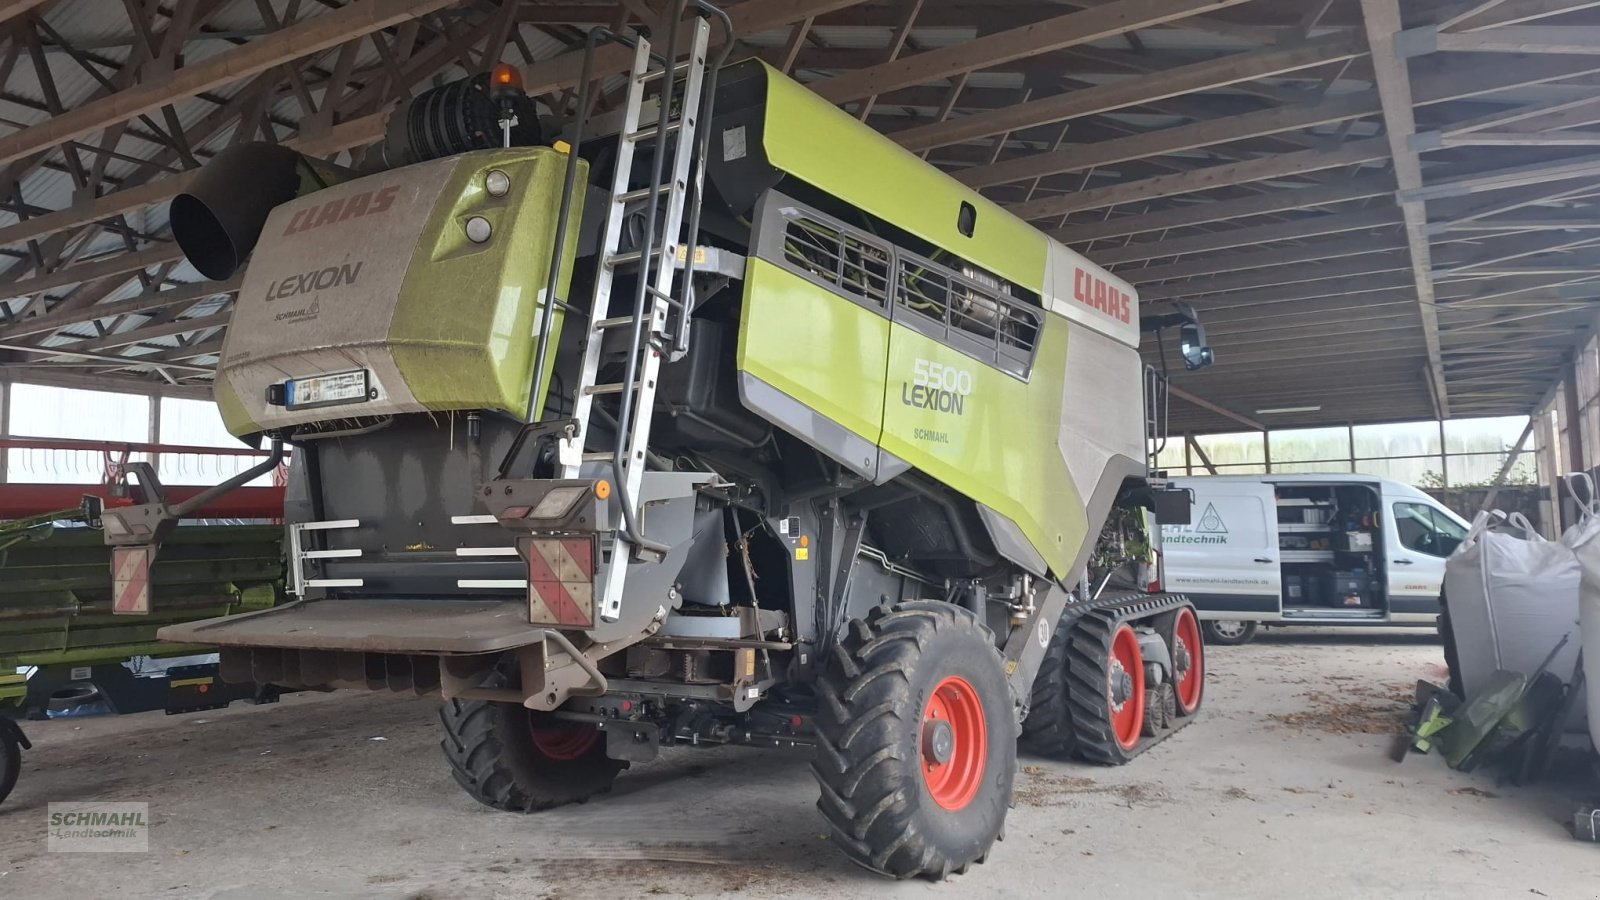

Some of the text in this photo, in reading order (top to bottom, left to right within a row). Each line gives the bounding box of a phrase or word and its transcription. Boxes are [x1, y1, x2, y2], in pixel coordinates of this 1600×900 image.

[283, 185, 400, 237] CLAAS
[265, 261, 363, 302] LEXION
[1074, 267, 1130, 325] CLAAS
[913, 358, 972, 396] 5500
[902, 381, 964, 416] LEXION
[913, 428, 949, 444] SCHMAHL
[1161, 535, 1228, 544] andtechnik
[1039, 623, 1048, 643] 30
